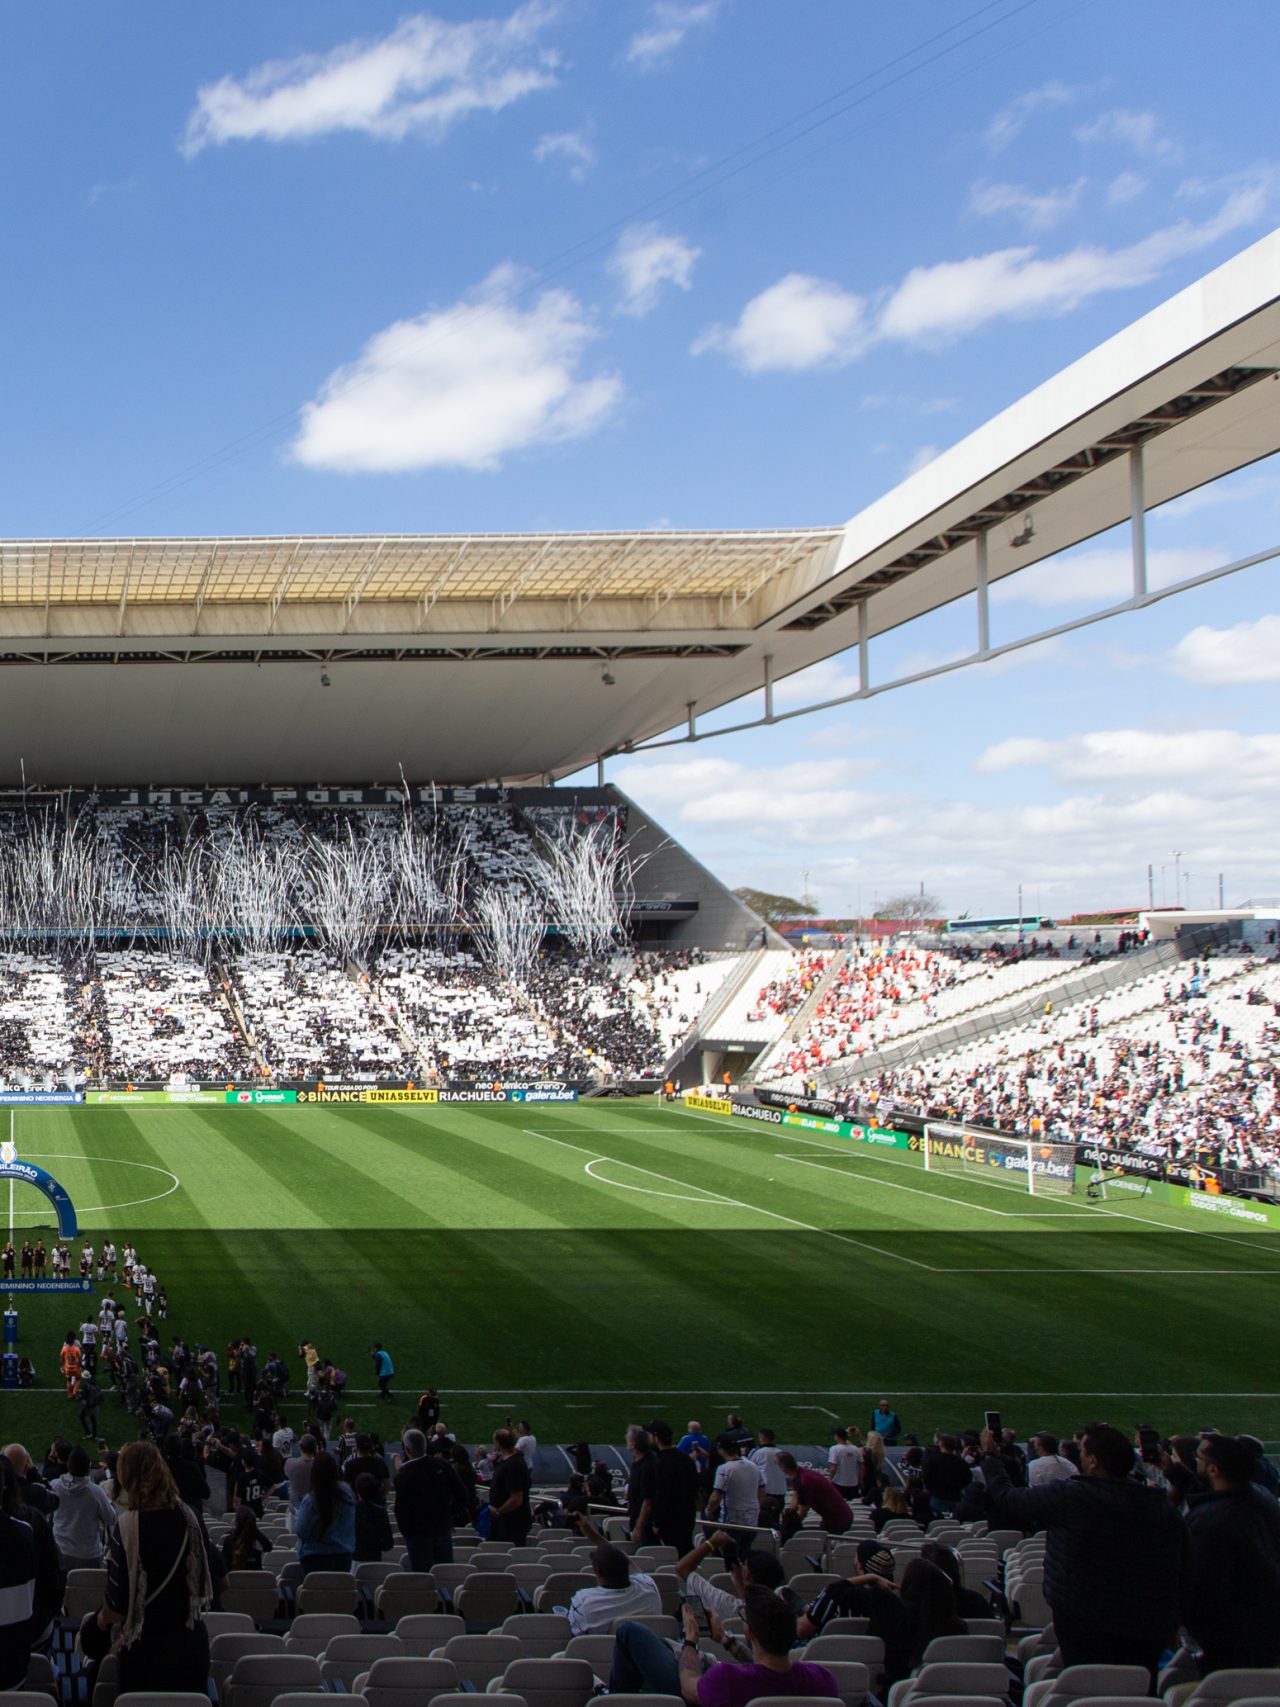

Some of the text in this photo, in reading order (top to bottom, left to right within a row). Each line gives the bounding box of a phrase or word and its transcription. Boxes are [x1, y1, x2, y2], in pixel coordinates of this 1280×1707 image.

[273, 790, 371, 804] POR
[308, 1091, 367, 1102] BINANCE
[370, 1092, 435, 1101] UNIASSELVI
[439, 1091, 507, 1102] RIACHUELO
[525, 1091, 574, 1102] galera.bet
[688, 1096, 731, 1114] UNIASSELVI
[732, 1103, 782, 1123] RIACHUELO
[36, 1282, 81, 1290] NEOENERGIA
